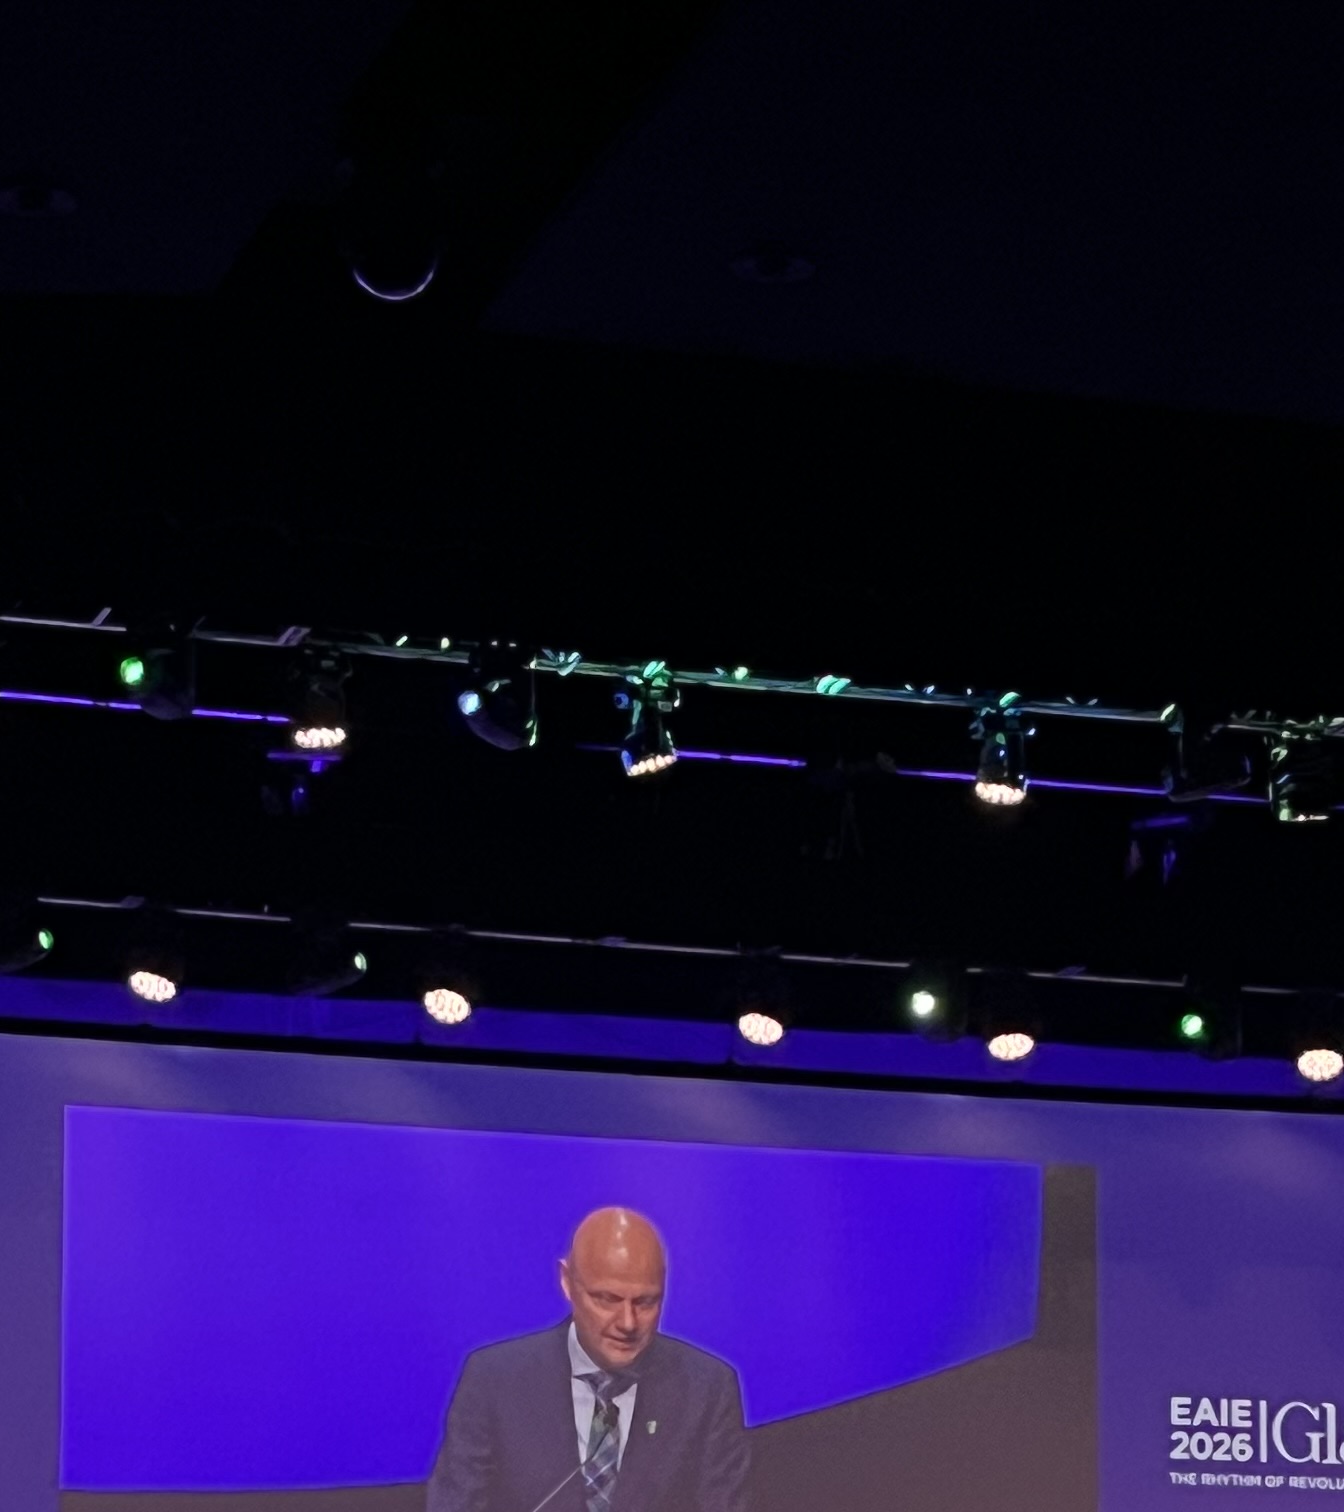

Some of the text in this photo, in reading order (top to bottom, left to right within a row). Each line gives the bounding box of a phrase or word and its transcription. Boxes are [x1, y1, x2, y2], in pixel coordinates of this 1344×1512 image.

[1170, 1396, 1253, 1428] EAIE
[1169, 1430, 1254, 1462] 2026
[1169, 1471, 1197, 1486] THE
[1264, 1474, 1285, 1488] OF
